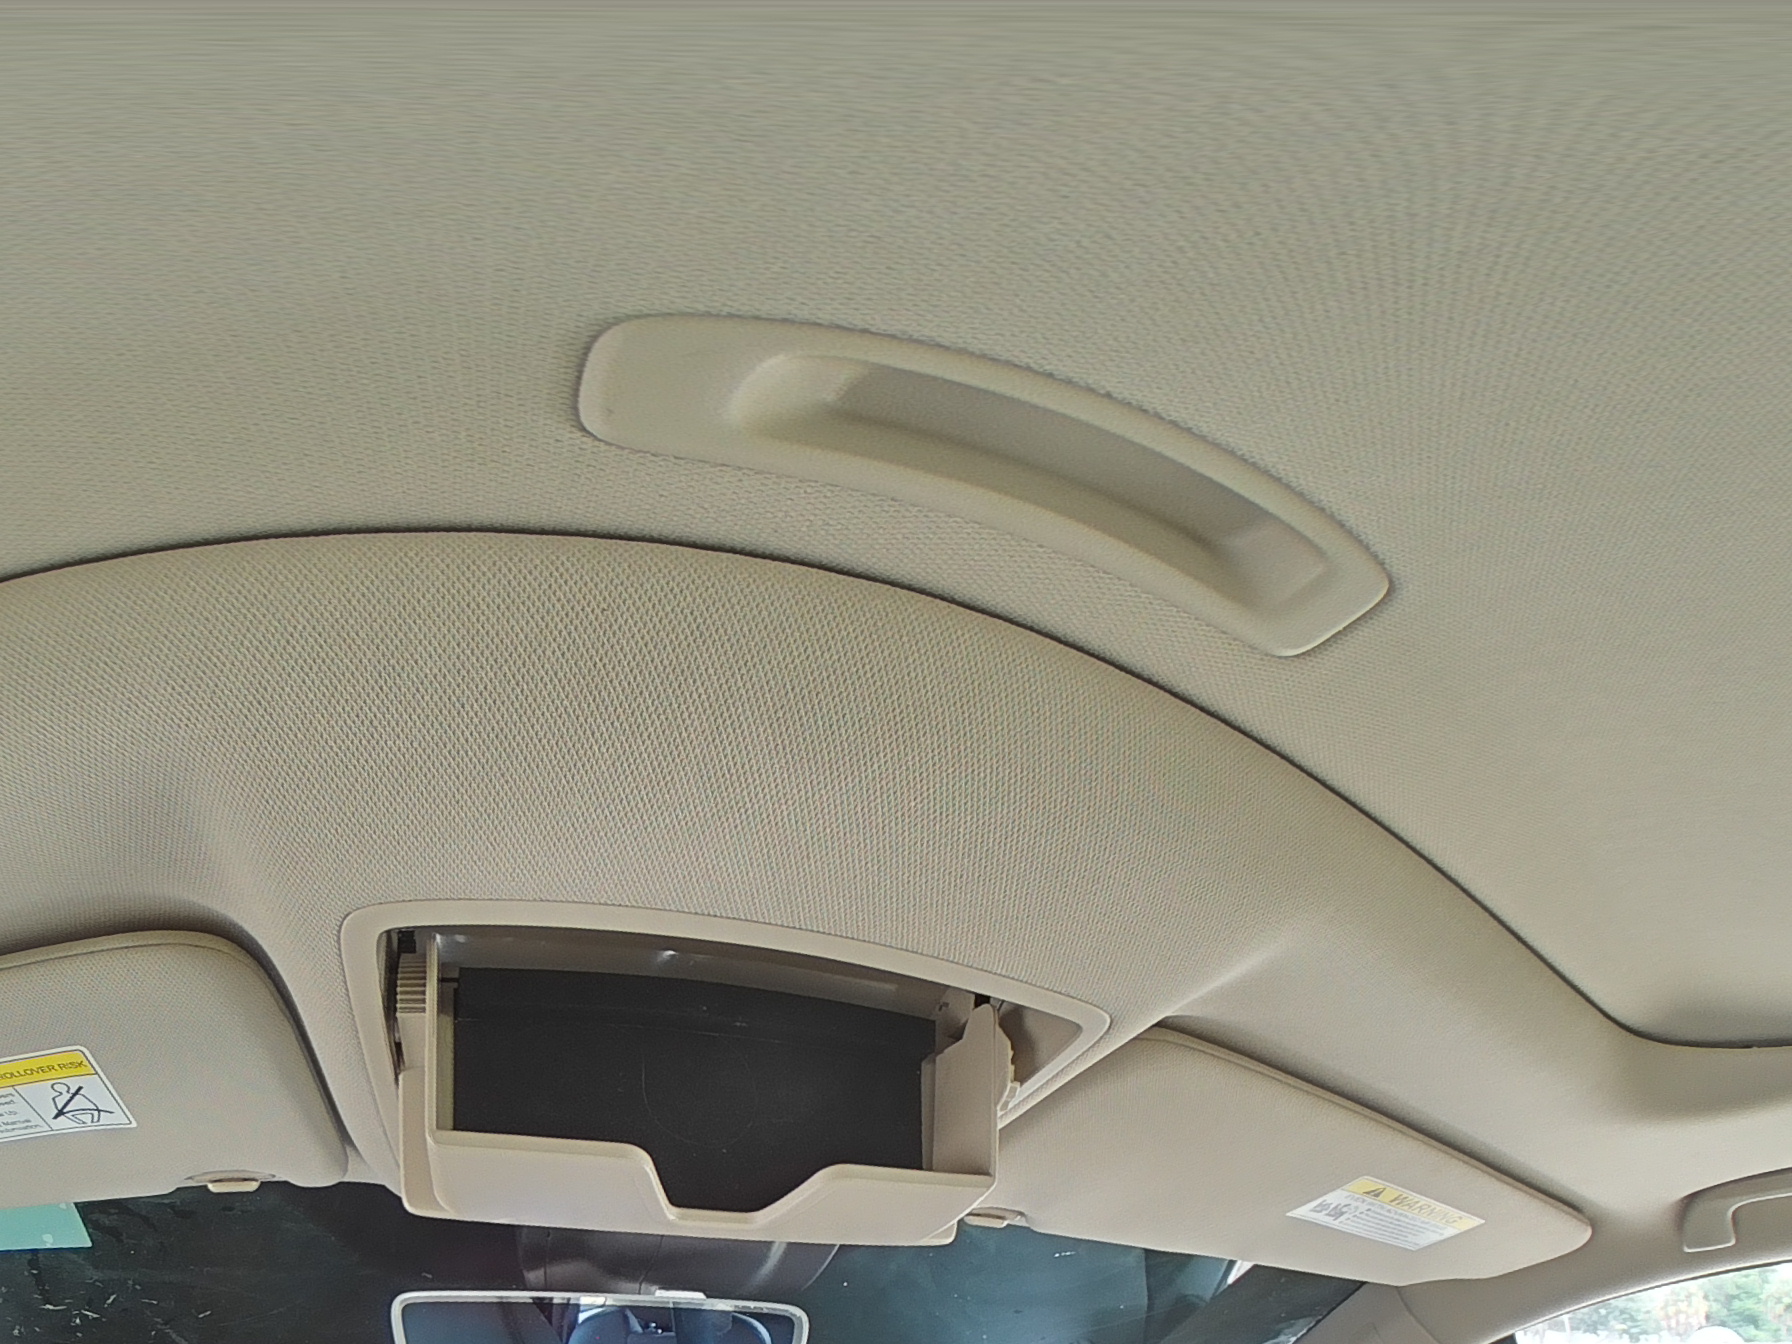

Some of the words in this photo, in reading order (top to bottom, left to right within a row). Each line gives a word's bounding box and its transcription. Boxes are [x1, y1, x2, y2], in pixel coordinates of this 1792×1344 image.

[58, 1059, 88, 1072] RISK
[4, 1118, 32, 1127] Manual
[1388, 1193, 1464, 1225] WARNING
